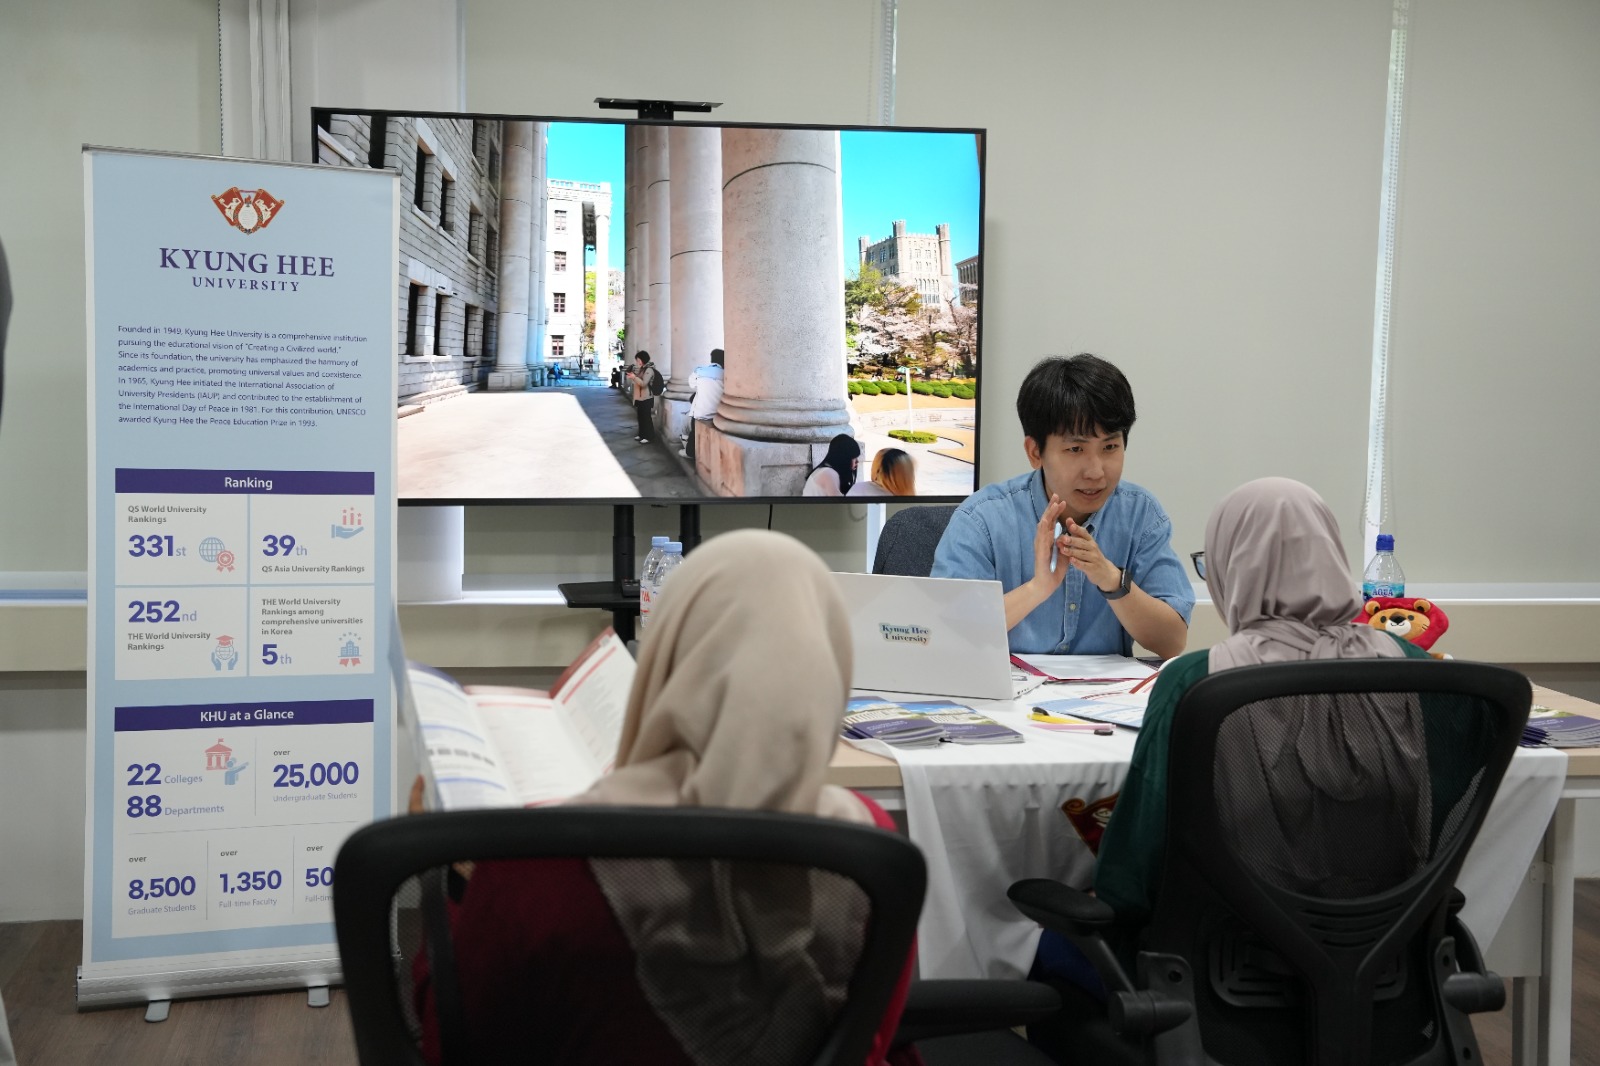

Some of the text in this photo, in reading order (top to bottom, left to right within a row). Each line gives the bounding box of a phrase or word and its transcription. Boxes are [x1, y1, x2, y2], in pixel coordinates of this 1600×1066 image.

[159, 247, 335, 277] KYUNG HEE
[192, 276, 300, 292] UNIVERSITY
[118, 325, 152, 334] Founded
[153, 326, 161, 334] in
[184, 328, 208, 337] Kyung
[210, 329, 225, 337] Hee
[227, 330, 262, 340] University
[278, 332, 332, 341] comprehensive
[333, 334, 368, 342] institution
[118, 339, 152, 348] pursuing
[167, 340, 211, 349] educational
[212, 342, 234, 350] vision
[286, 345, 315, 353] Civilized
[118, 351, 139, 359] Since
[140, 351, 149, 359] its
[151, 352, 194, 361] foundation,
[209, 355, 244, 364] university
[246, 356, 258, 364] has
[260, 357, 303, 365] emphasized
[318, 358, 349, 367] harmony
[350, 359, 359, 367] of
[118, 365, 158, 373] academics
[208, 368, 247, 376] promoting
[150, 378, 174, 387] Kyung
[238, 381, 284, 389] International
[285, 382, 326, 390] Association
[118, 390, 156, 399] University
[157, 391, 196, 399] Presidents
[222, 392, 236, 400] and
[237, 393, 280, 401] contributed
[304, 395, 353, 403] establishment
[354, 396, 362, 404] of
[118, 402, 131, 410] the
[133, 403, 180, 411] International
[182, 404, 197, 413] Day
[261, 406, 274, 414] For
[153, 416, 177, 425] Kyung
[233, 418, 269, 426] Education
[270, 419, 288, 427] Prize
[224, 477, 273, 490] Ranking
[128, 505, 207, 514] QS World University
[127, 515, 167, 525] Rankings
[261, 565, 273, 573] QS
[291, 565, 330, 574] University
[331, 565, 365, 573] Rankings
[1372, 588, 1394, 597] AQUA
[262, 598, 341, 606] THE World University
[261, 608, 297, 616] Rankings
[261, 617, 363, 626] comprehensive universities
[881, 624, 929, 635] Kyung Hee
[127, 631, 211, 641] THE World University
[885, 632, 927, 644] University
[127, 643, 165, 651] Rankings
[200, 708, 295, 722] KHU at a Glance
[126, 763, 203, 786] 22 Colleges
[272, 761, 359, 788] 25,000
[273, 792, 358, 803] Undergraduate Students
[126, 794, 225, 818] 88 Departments
[128, 875, 196, 901] 8,500
[219, 869, 282, 895] 1,350
[252, 897, 278, 907] Faculty
[128, 904, 197, 916] Graduate Students
